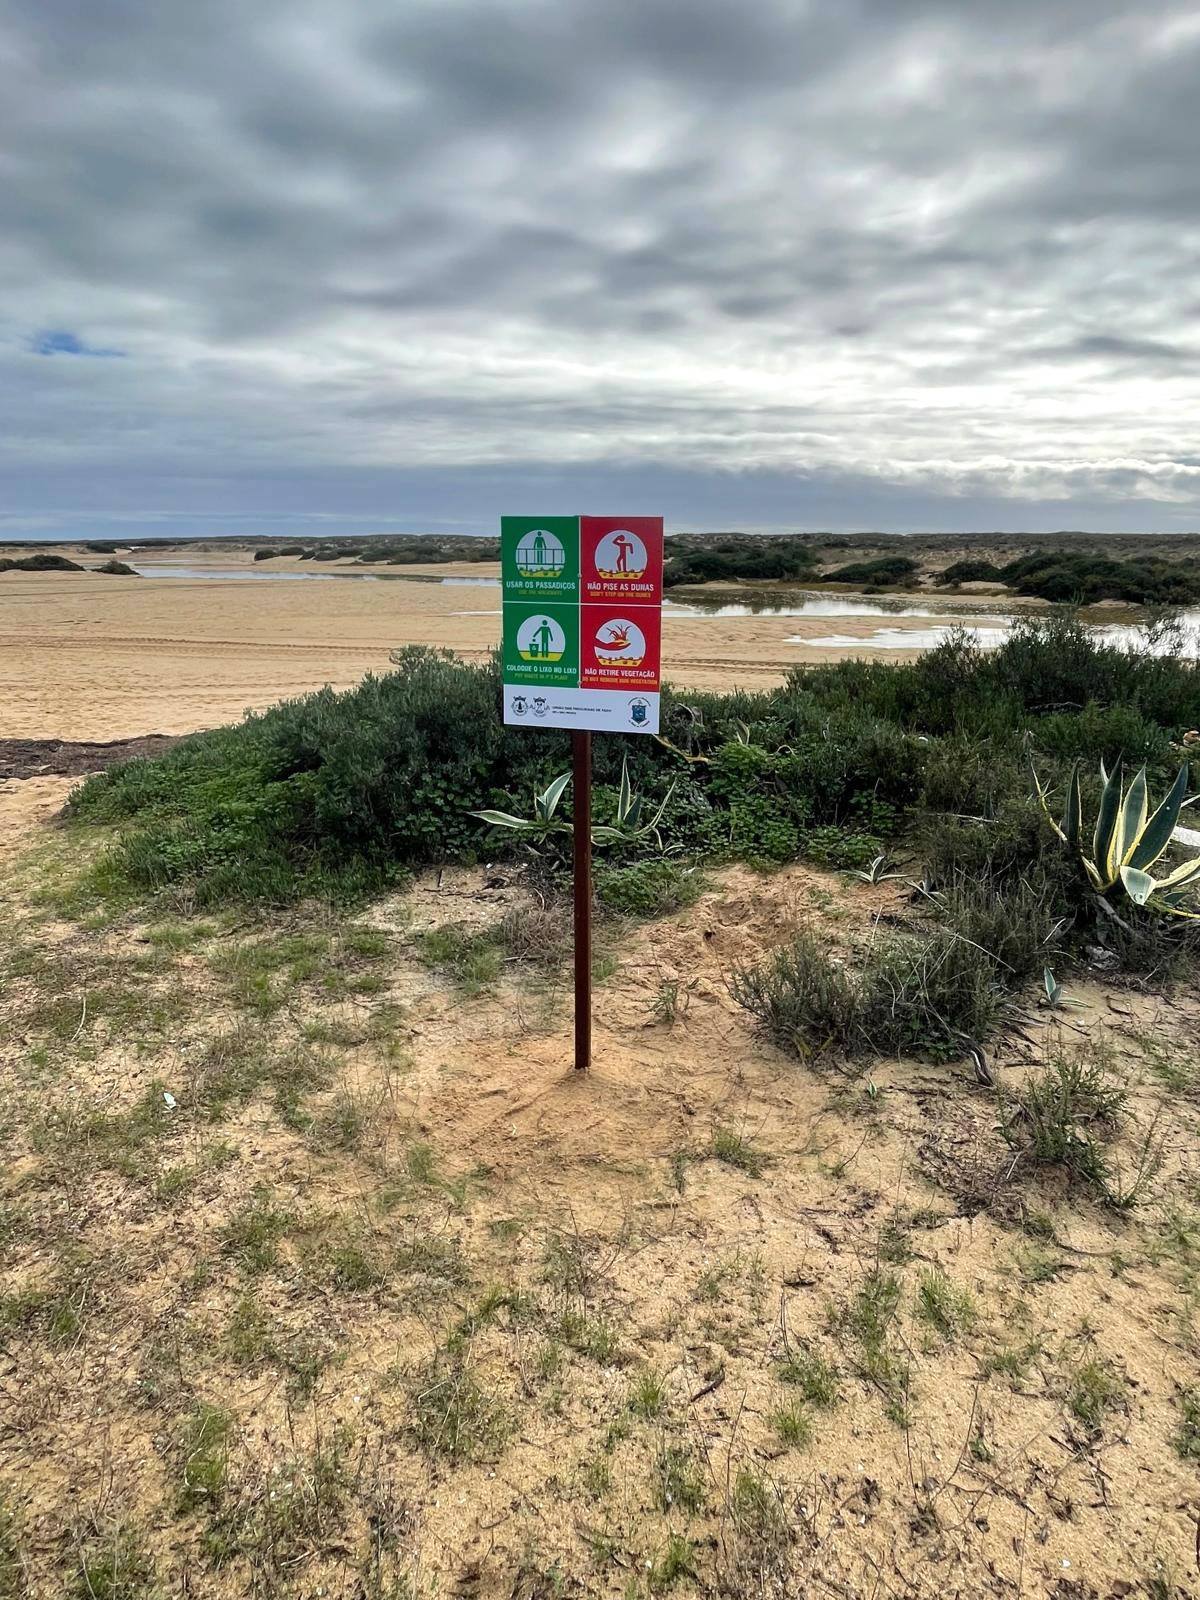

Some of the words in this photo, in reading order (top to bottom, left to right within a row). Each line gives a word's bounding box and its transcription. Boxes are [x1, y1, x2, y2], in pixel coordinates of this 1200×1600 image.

[536, 581, 576, 590] PASSADIÇOS
[587, 581, 602, 590] NÃO
[602, 582, 618, 590] PISE
[620, 583, 628, 591] AS
[630, 583, 654, 592] DUNAS
[621, 670, 655, 678] VEGETAÇÃO
